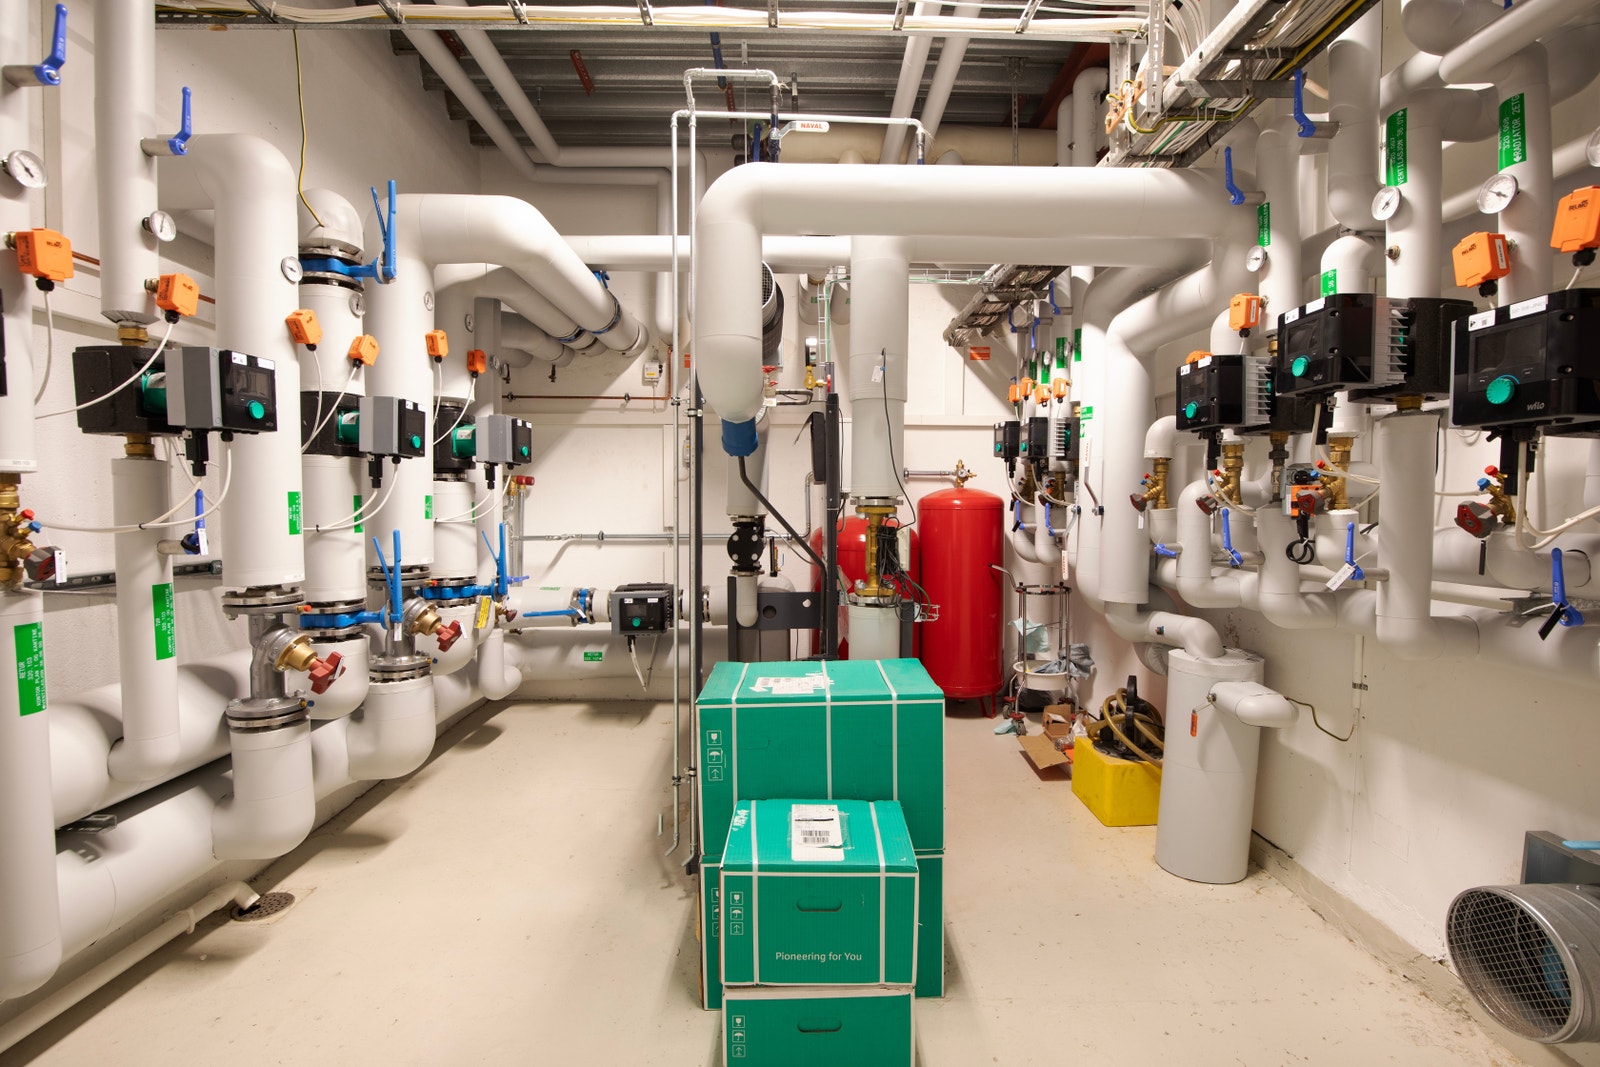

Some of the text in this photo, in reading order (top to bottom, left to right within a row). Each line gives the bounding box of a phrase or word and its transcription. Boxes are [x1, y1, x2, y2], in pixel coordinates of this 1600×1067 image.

[1512, 118, 1522, 156] RADIATOR
[1396, 139, 1405, 186] VENTILASJON
[1526, 401, 1545, 411] wilo
[18, 661, 26, 679] RETUR
[775, 951, 862, 963] Pioneering for You
